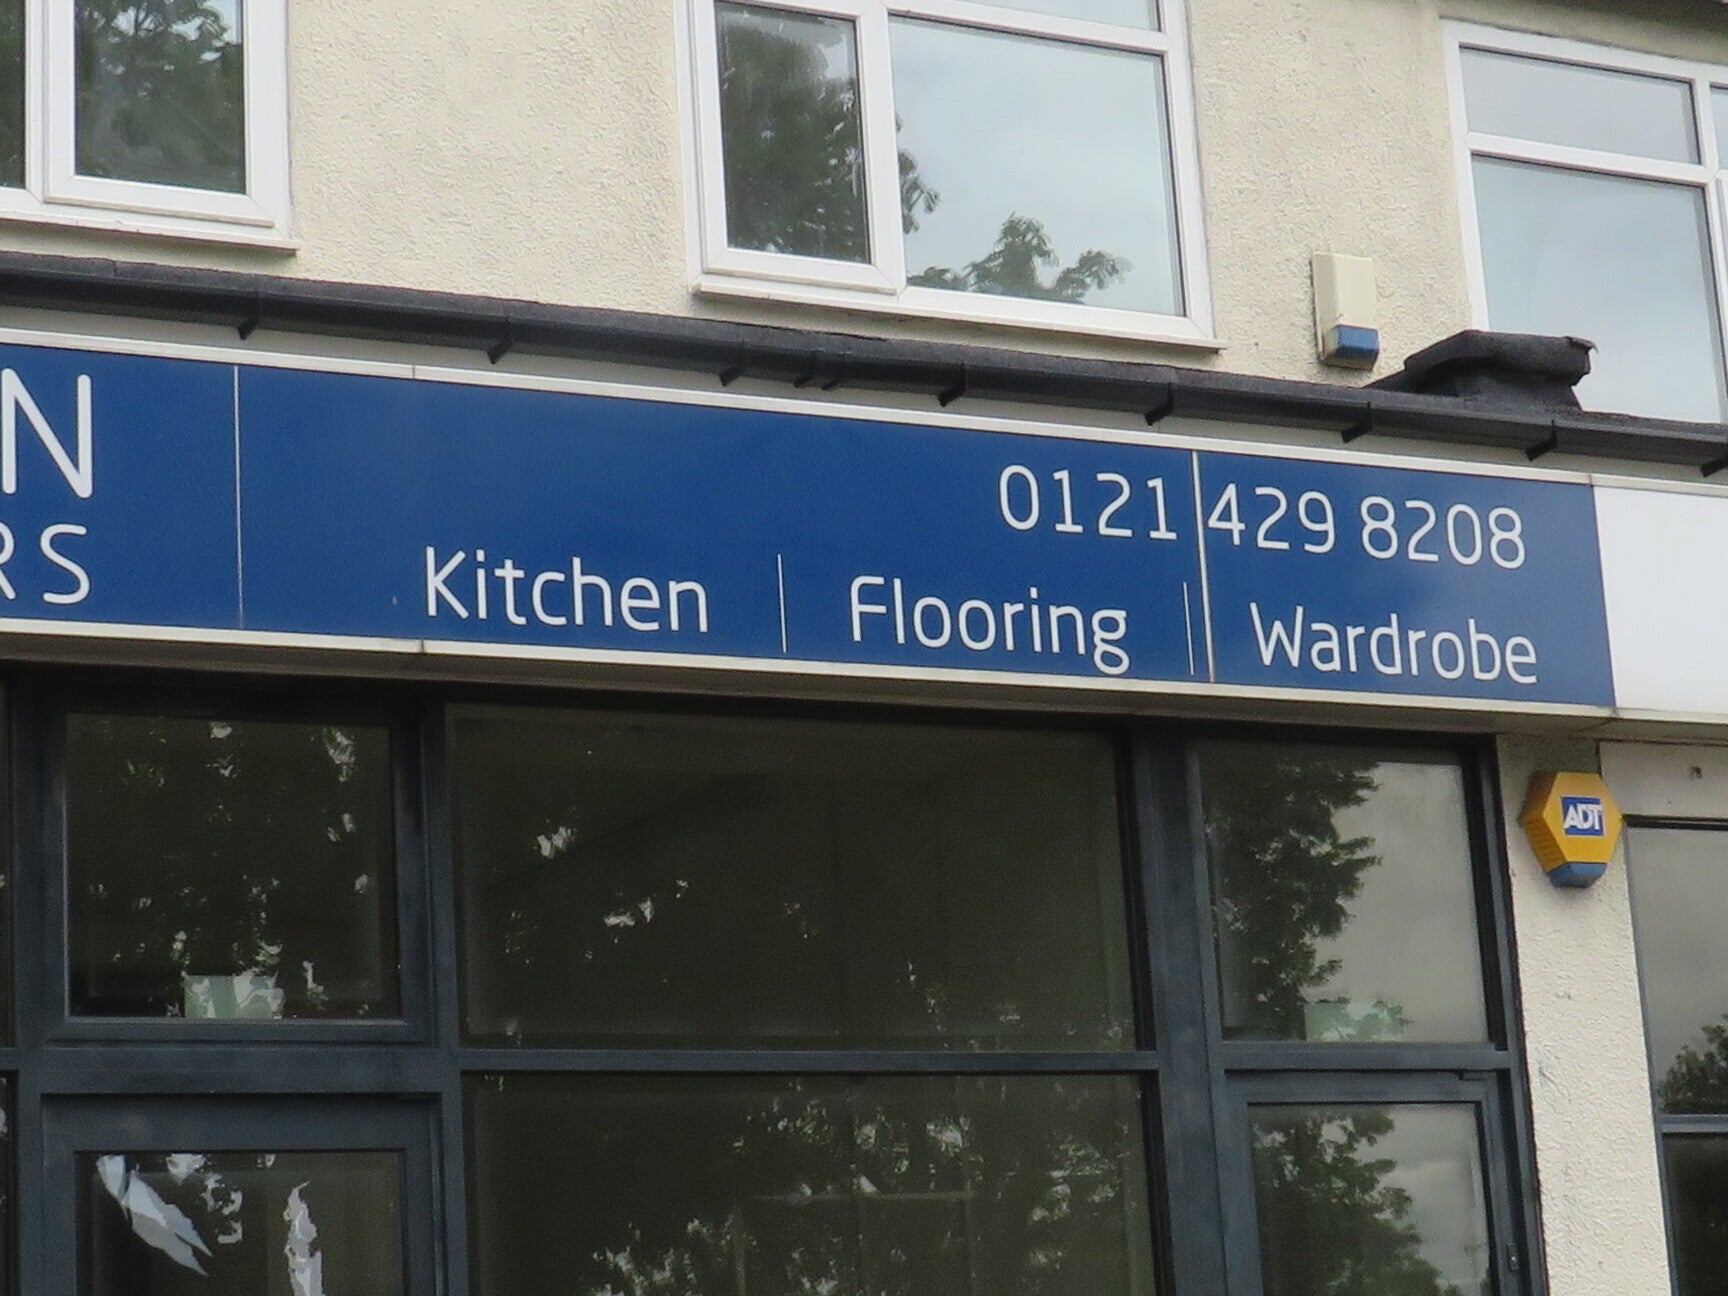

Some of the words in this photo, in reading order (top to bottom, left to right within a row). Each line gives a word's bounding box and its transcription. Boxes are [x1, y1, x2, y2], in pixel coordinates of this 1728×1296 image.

[999, 465, 1177, 541] 0121
[1207, 483, 1335, 555] 429
[1360, 496, 1526, 570] 8208
[425, 546, 709, 634] Kitchen
[850, 575, 1131, 676] Flooring
[1250, 602, 1539, 686] Wardrobe
[1563, 802, 1603, 831] ADT
